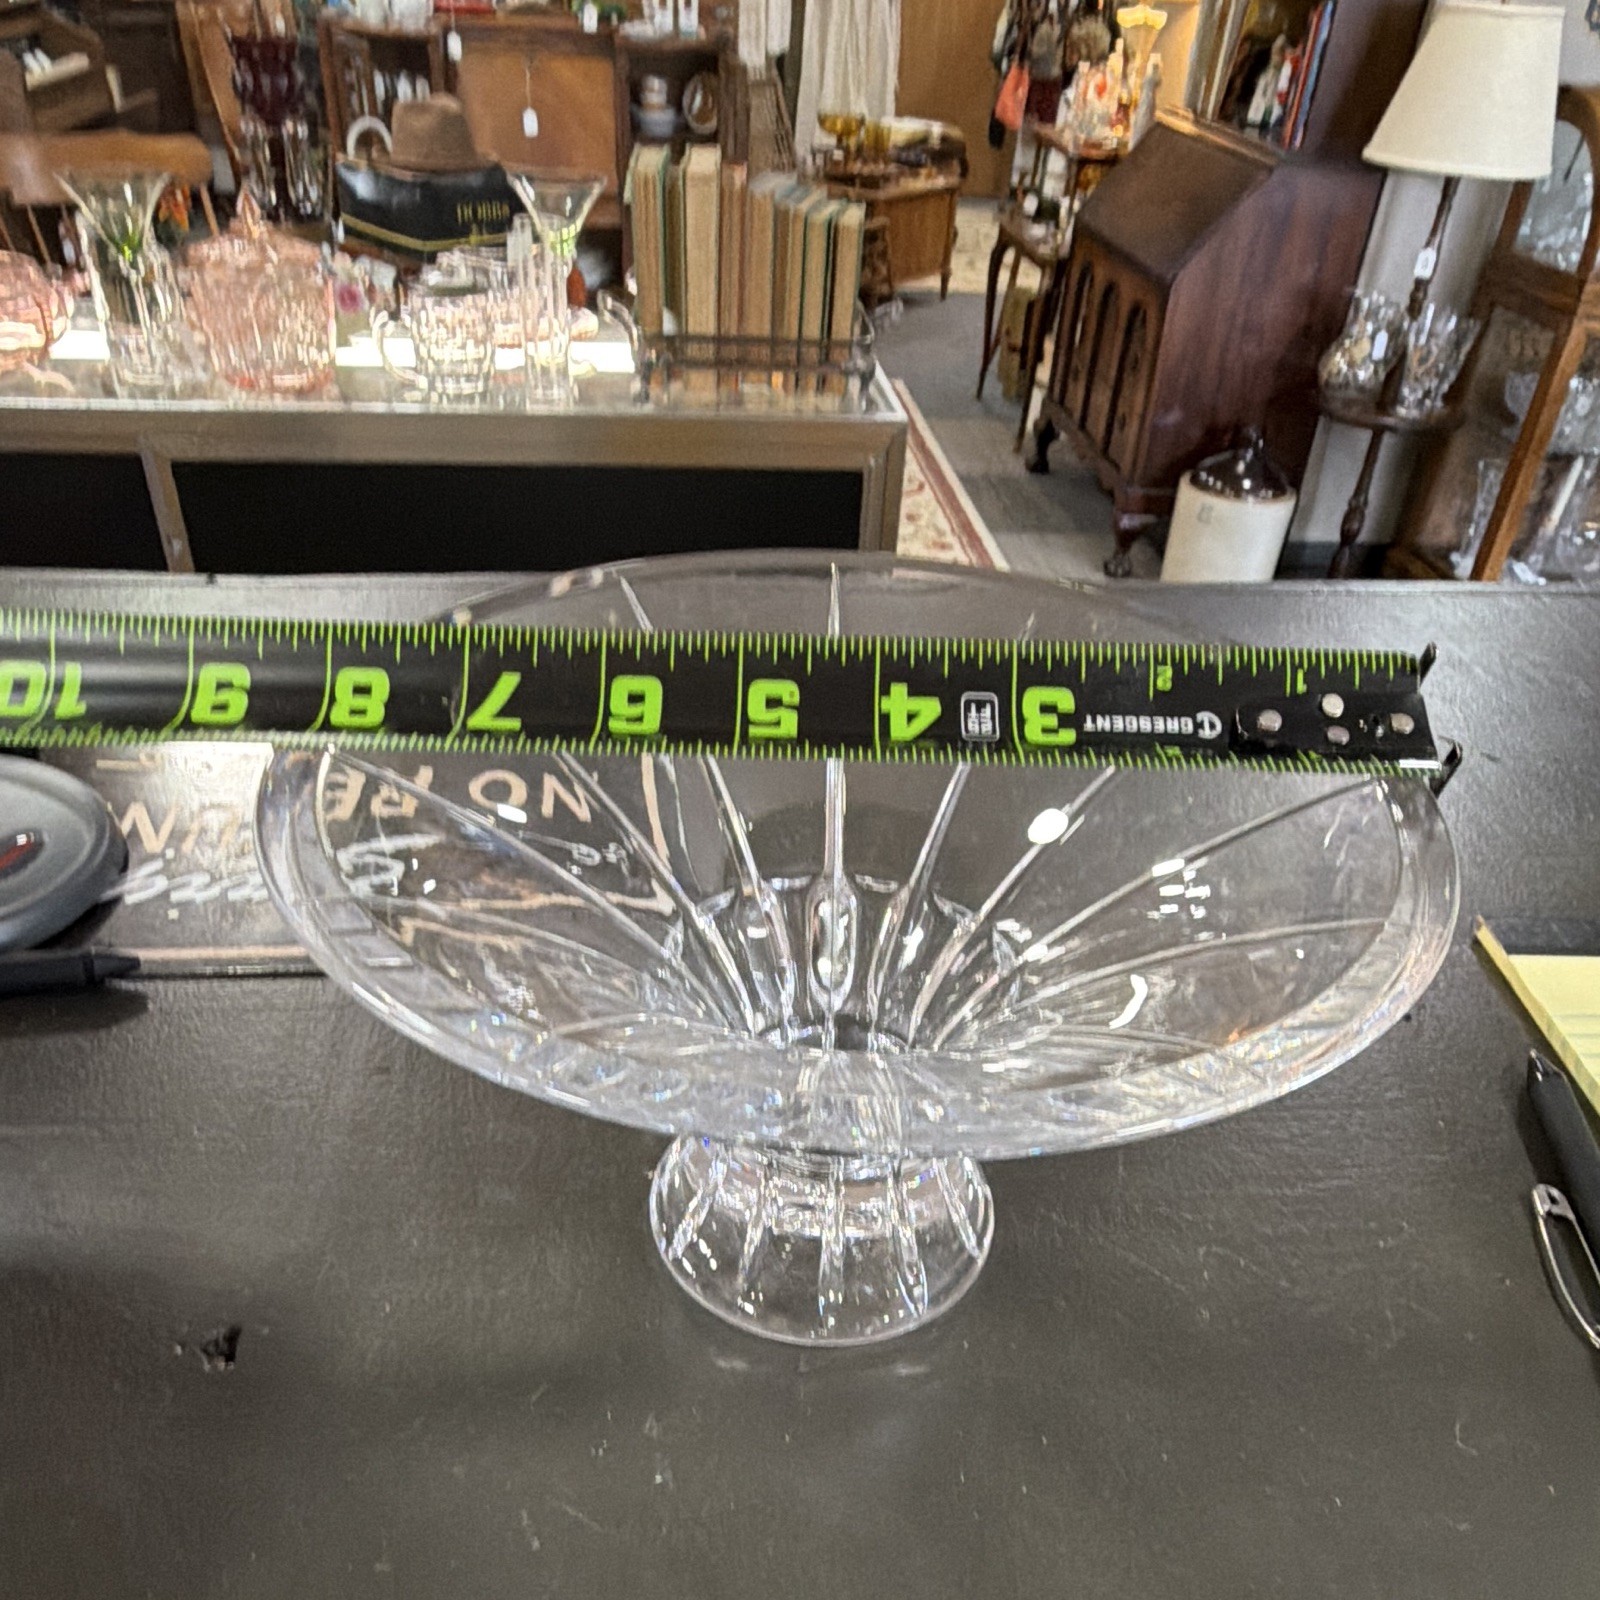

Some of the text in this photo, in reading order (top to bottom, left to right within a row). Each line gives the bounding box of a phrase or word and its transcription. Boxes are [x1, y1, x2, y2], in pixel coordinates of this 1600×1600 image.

[1156, 665, 1308, 695] 1 2
[0, 659, 1076, 746] 3 4 5 6 7 8 9 10
[1083, 714, 1194, 735] CRESCENT
[468, 769, 599, 824] NO
